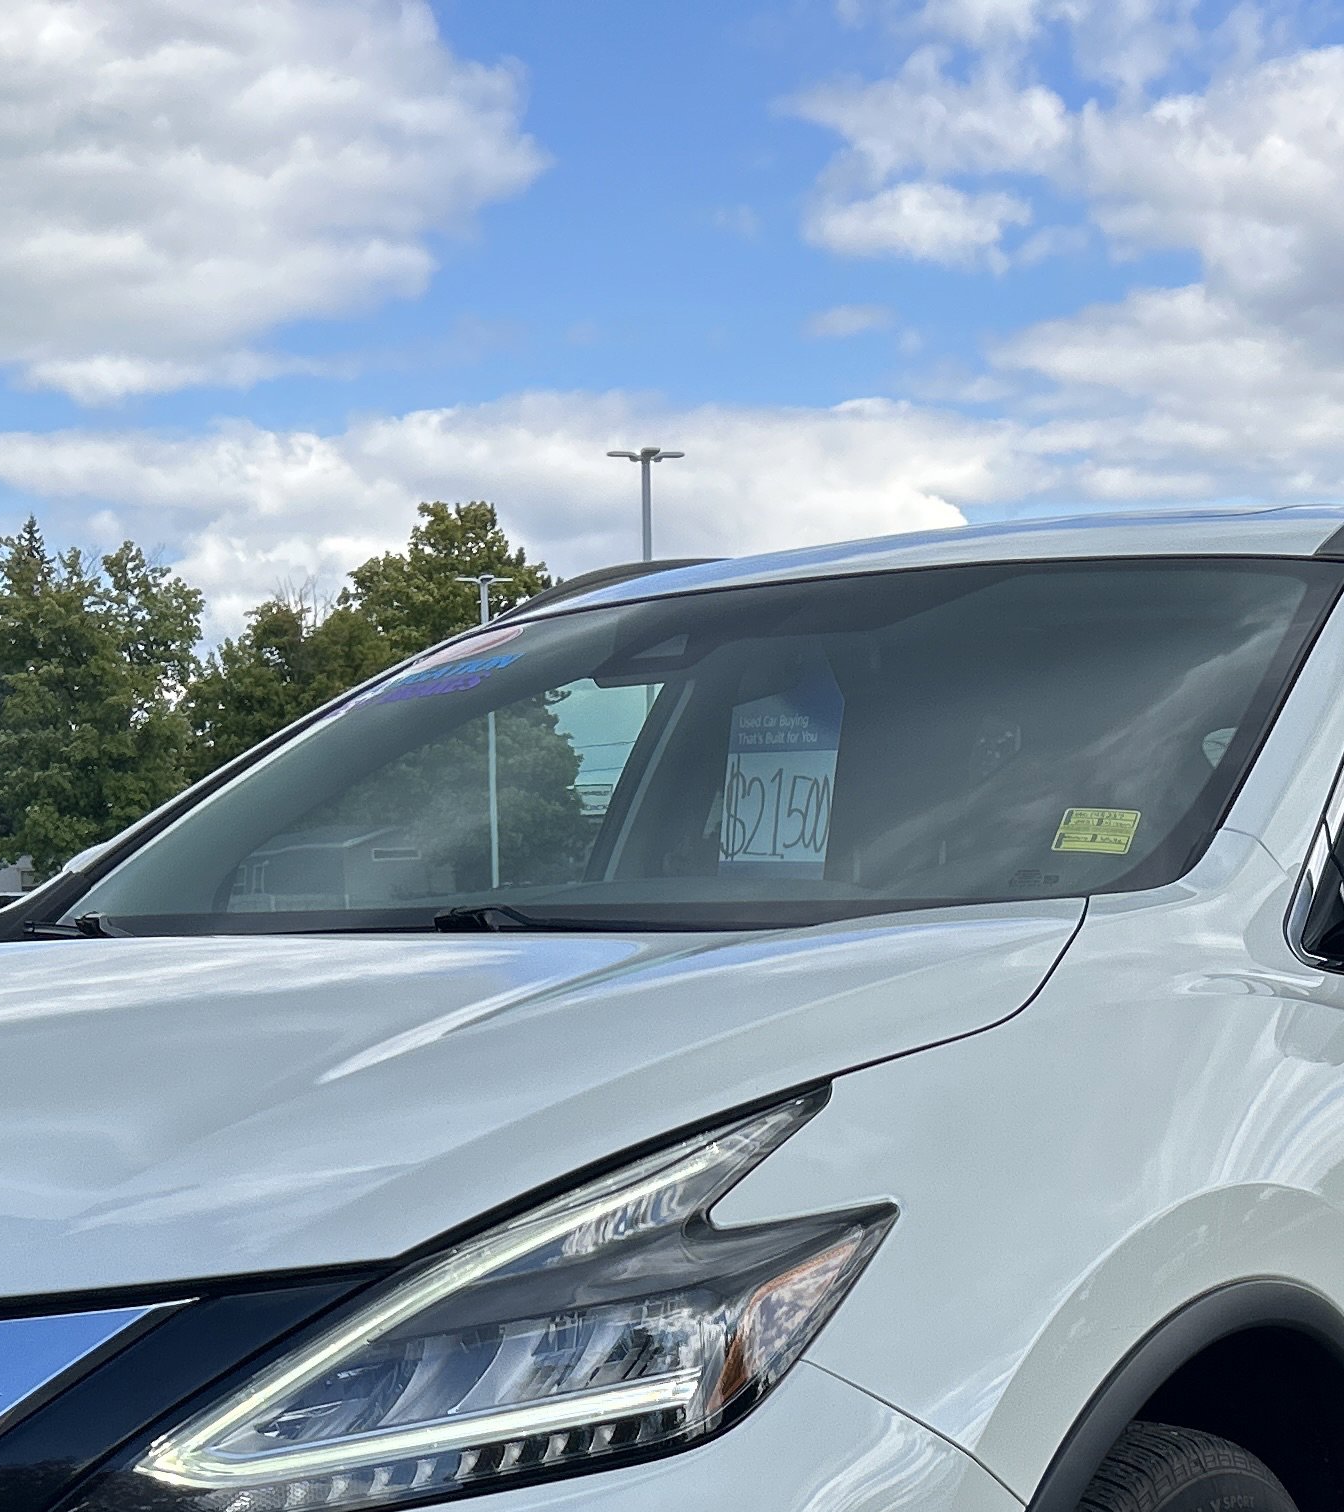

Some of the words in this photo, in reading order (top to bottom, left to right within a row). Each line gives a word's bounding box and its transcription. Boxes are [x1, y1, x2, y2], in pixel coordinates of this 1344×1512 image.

[740, 716, 761, 728] Used
[780, 713, 809, 729] Buying
[1223, 1495, 1255, 1510] SPORT
